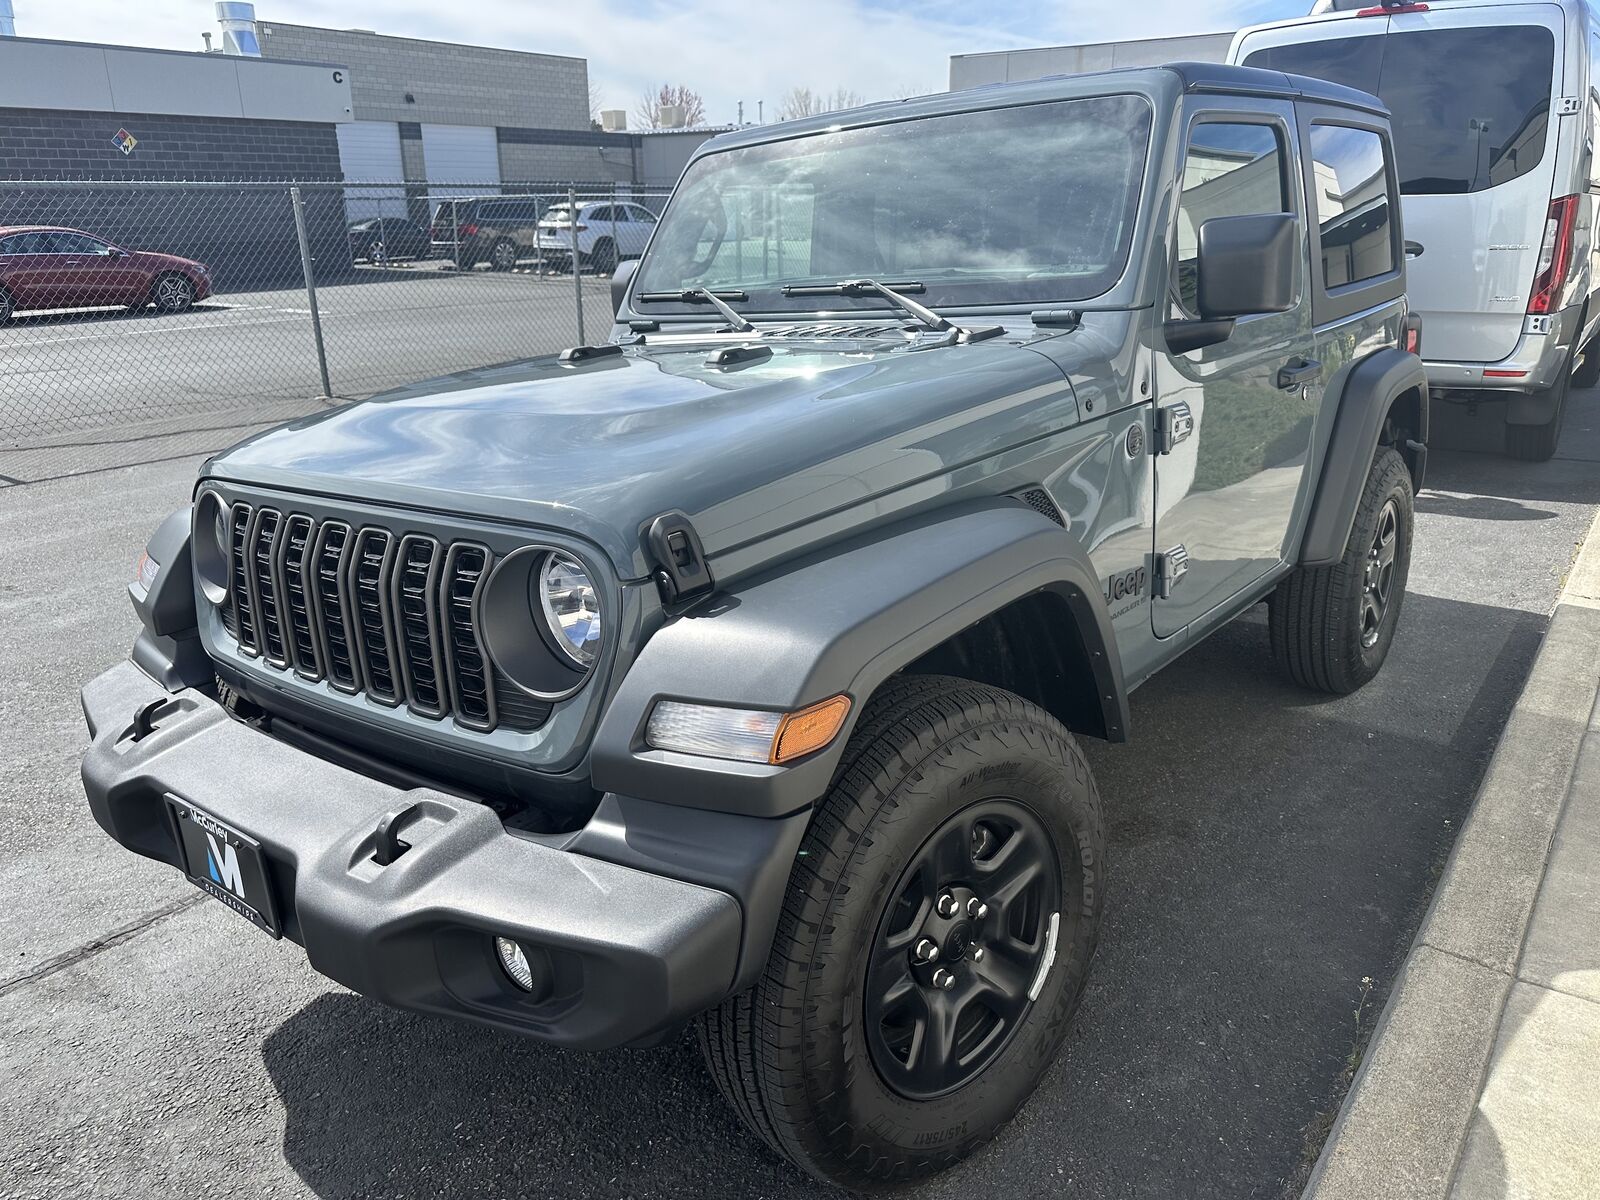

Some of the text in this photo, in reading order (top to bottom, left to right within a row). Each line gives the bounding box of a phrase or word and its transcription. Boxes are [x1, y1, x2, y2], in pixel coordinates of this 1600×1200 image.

[332, 71, 343, 84] C
[1103, 566, 1146, 606] Jeep
[959, 760, 1022, 789] All-Weather
[189, 808, 228, 843] McCurley
[204, 883, 254, 921] DEALERSHIPS
